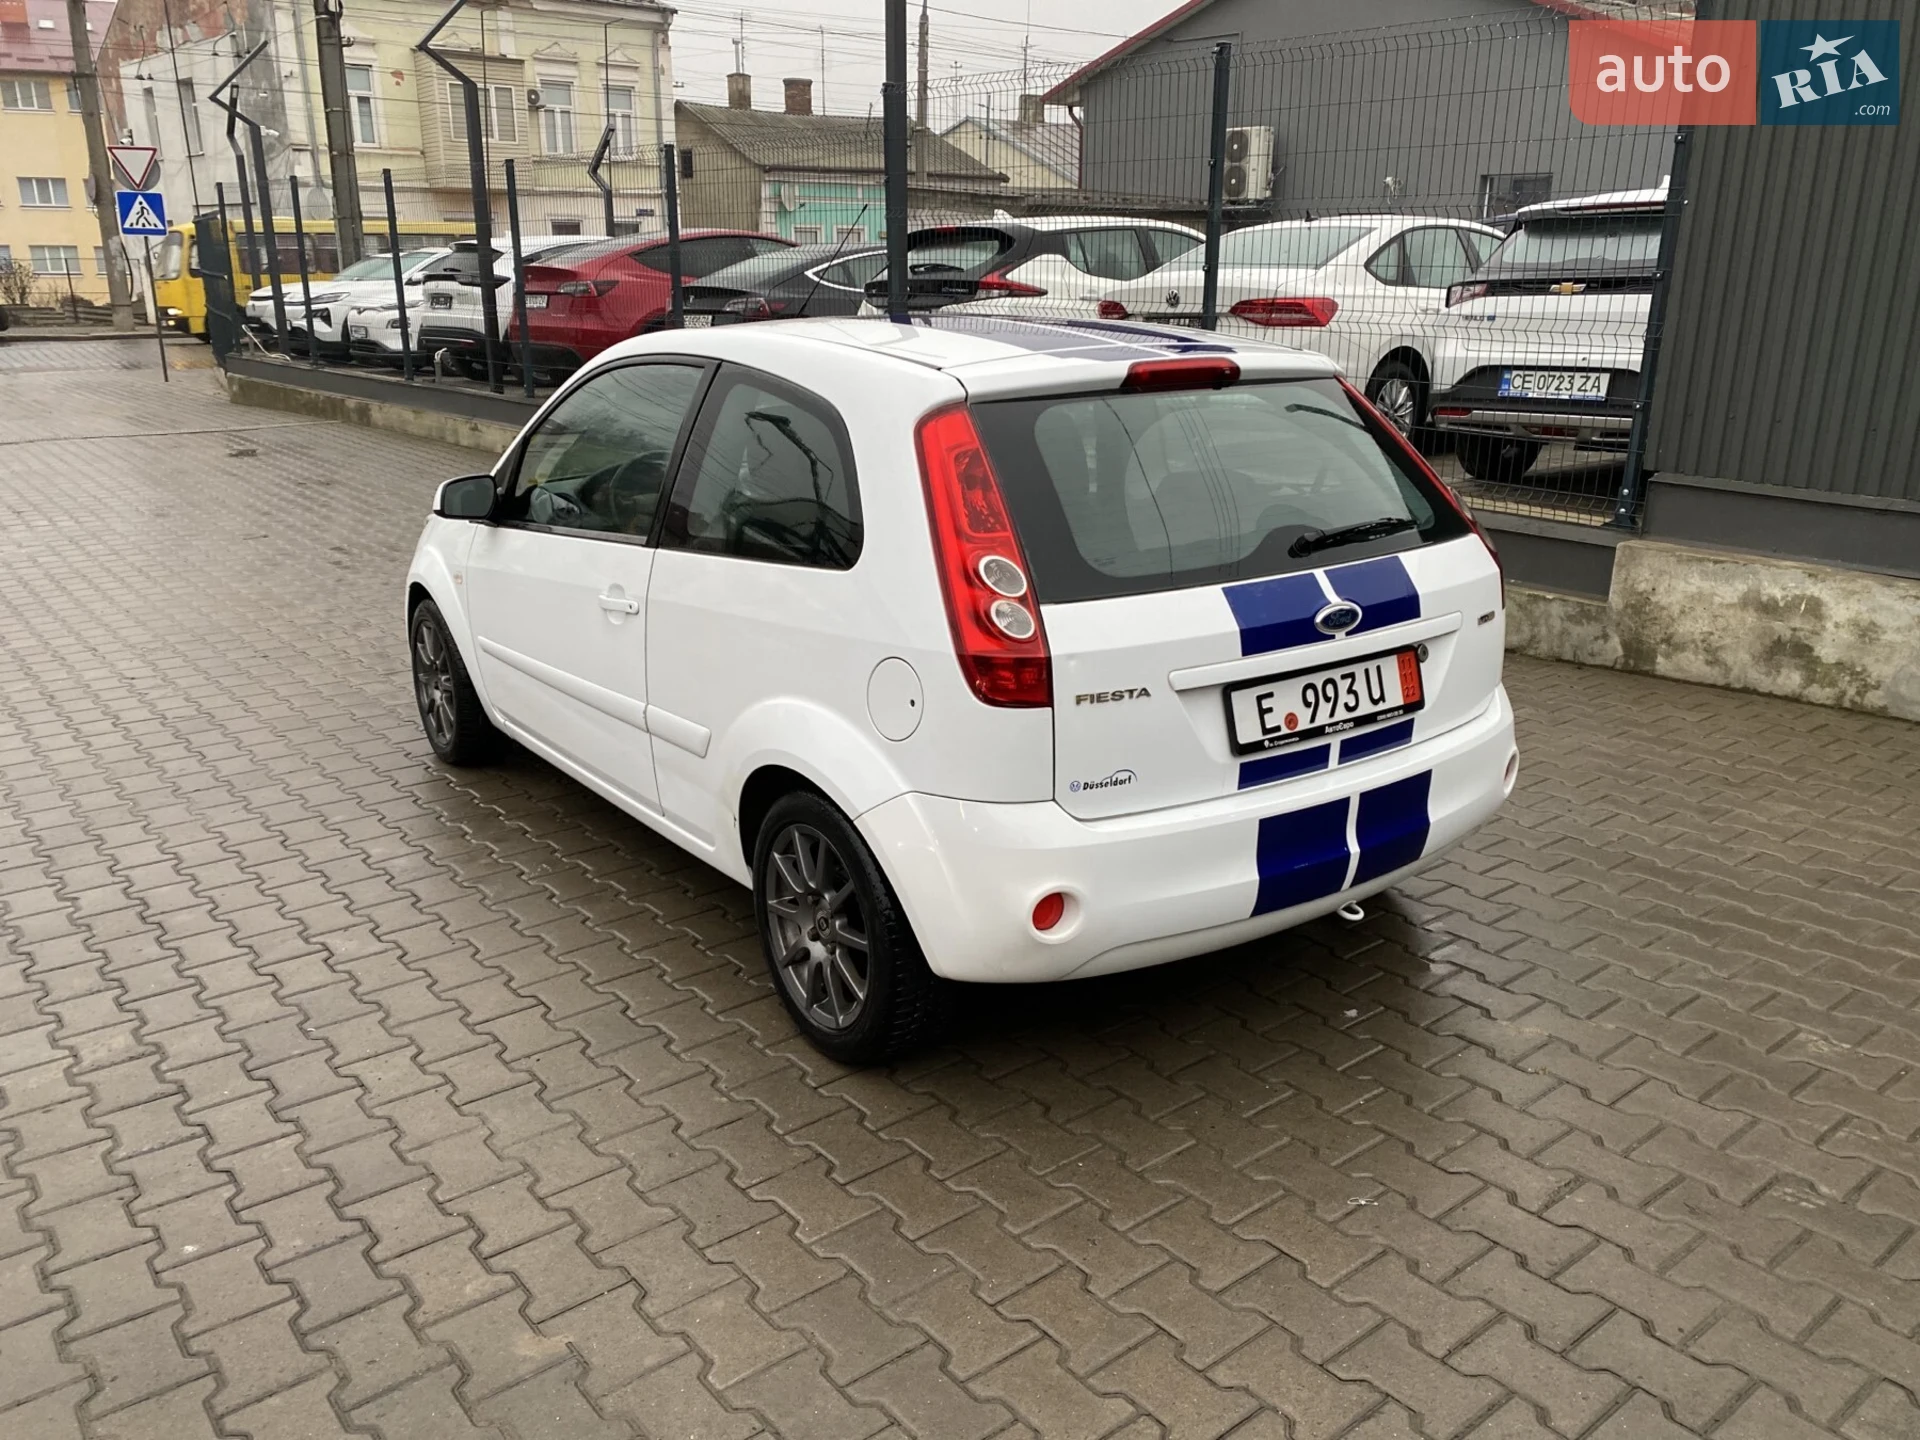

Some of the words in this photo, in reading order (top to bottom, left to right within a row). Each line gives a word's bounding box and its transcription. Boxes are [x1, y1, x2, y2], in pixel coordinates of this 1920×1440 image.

[1511, 374, 1534, 390] CE
[1536, 375, 1575, 391] 0723
[1577, 376, 1602, 393] ZA
[1075, 687, 1152, 706] FIESTA
[1256, 691, 1282, 736] E
[1083, 774, 1132, 790] Düsseldorf
